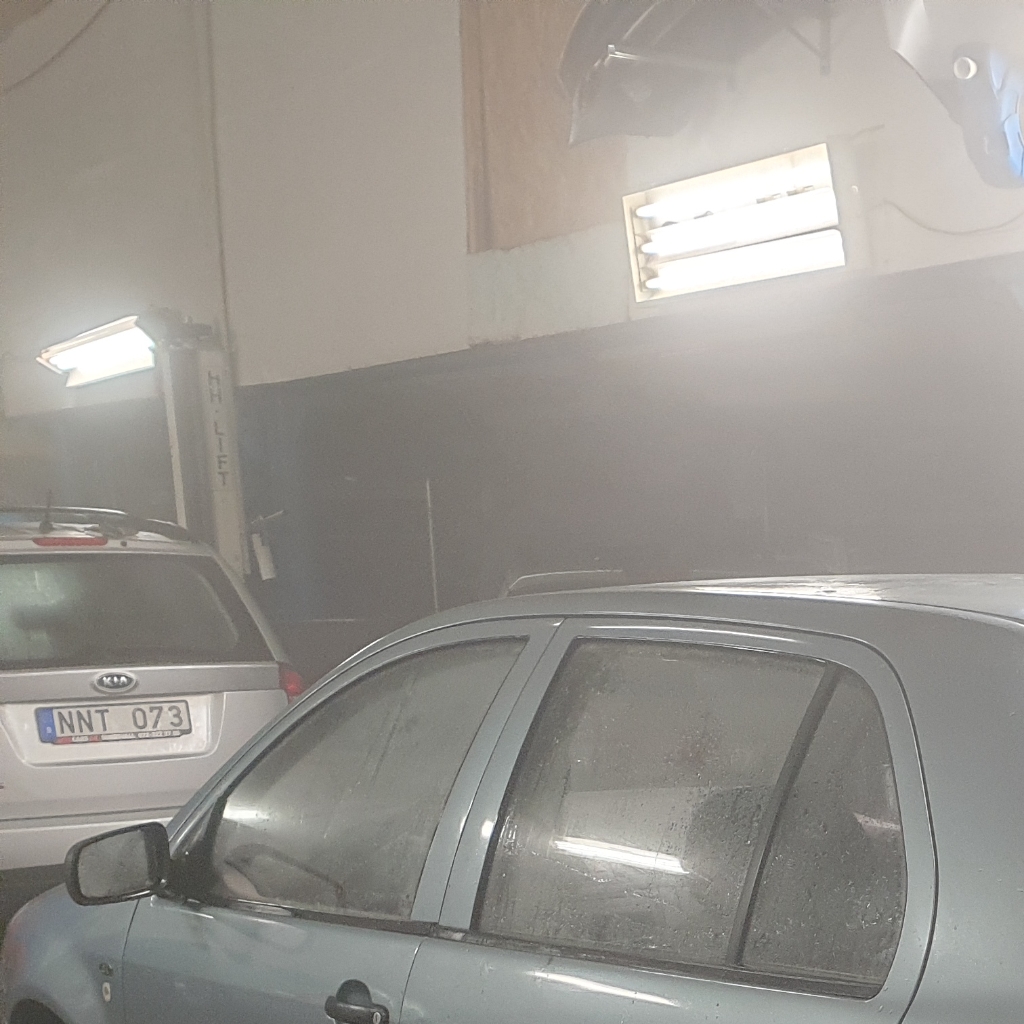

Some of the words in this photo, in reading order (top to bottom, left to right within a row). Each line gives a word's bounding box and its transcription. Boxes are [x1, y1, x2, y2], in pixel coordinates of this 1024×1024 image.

[103, 676, 128, 686] KIA
[57, 708, 109, 735] NNT
[132, 706, 184, 730] 073
